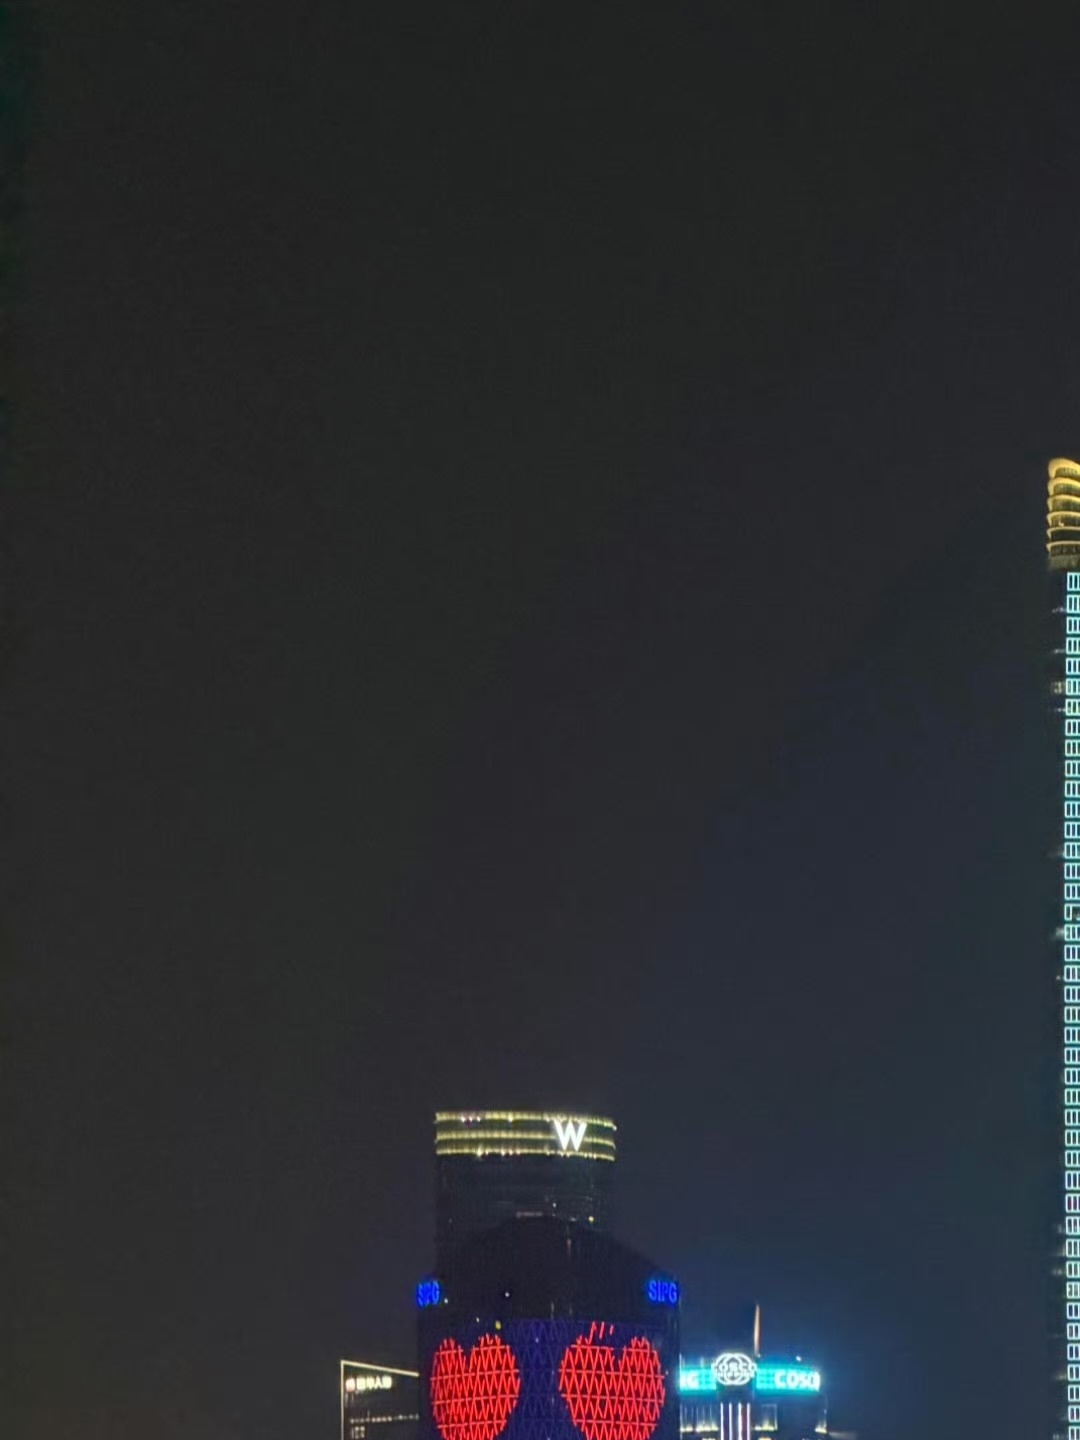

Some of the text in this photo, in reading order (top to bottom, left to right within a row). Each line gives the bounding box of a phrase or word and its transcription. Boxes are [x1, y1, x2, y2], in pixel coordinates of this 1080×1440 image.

[553, 1118, 588, 1152] W
[417, 1279, 441, 1307] SIPG
[648, 1279, 678, 1304] SIPG
